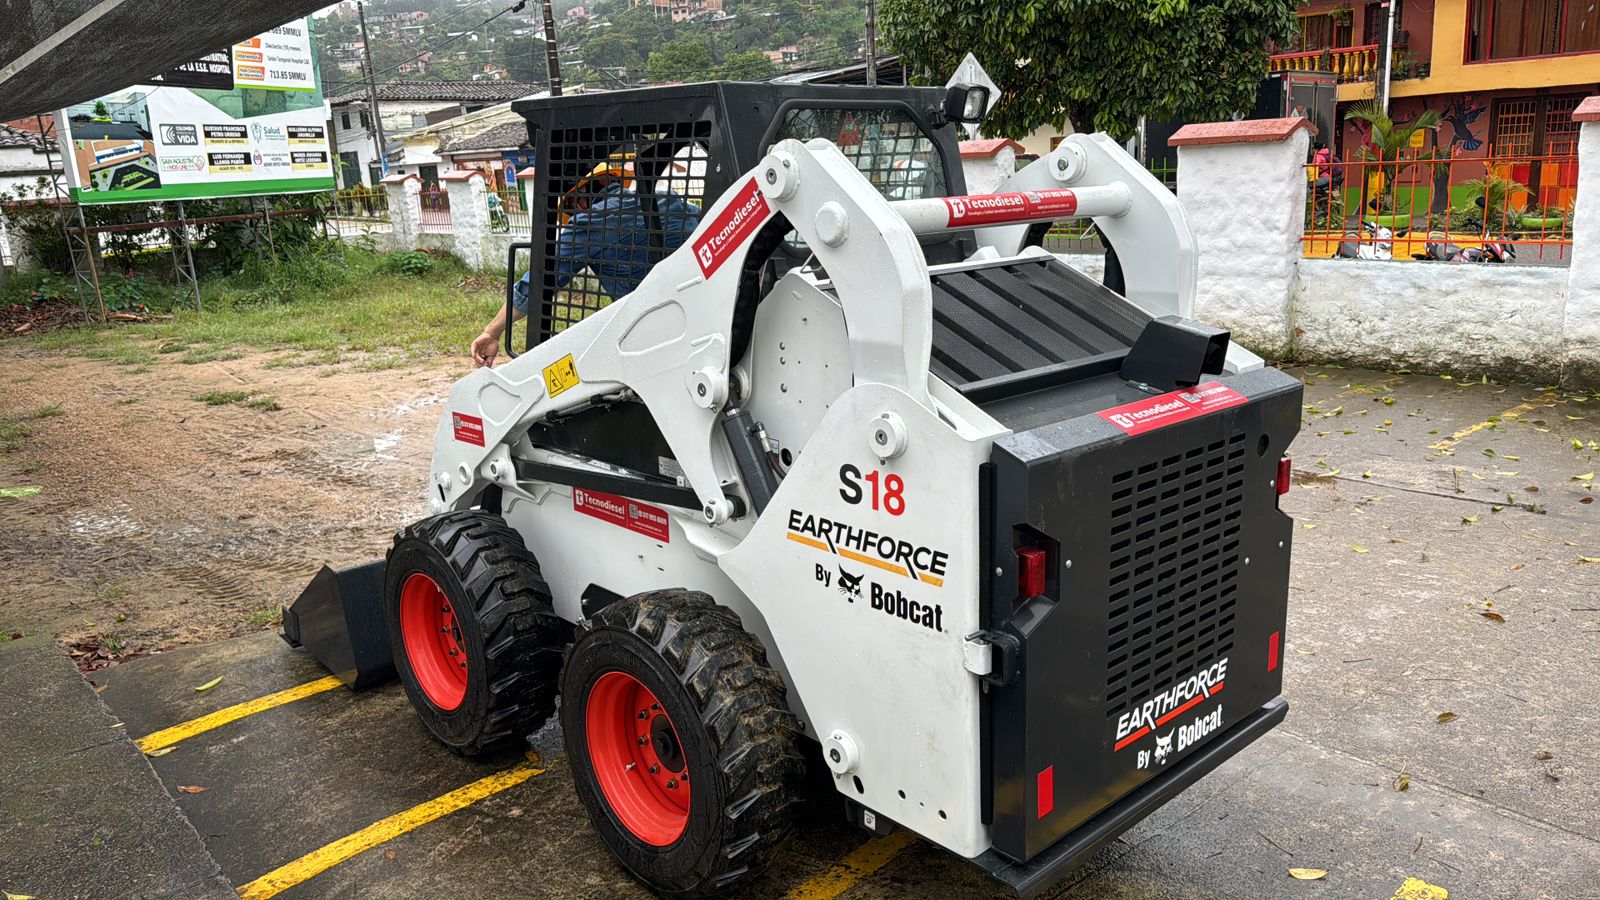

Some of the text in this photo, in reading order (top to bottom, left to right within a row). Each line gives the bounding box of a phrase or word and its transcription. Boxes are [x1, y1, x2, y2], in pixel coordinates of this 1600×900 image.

[187, 62, 194, 72] LA
[208, 64, 231, 74] HOSPITAL
[270, 70, 306, 80] 713.85 SMMLV
[176, 135, 196, 144] VIDA
[264, 126, 280, 134] Salud
[964, 195, 1024, 210] Tecnodiesel
[708, 190, 760, 250] Tecnodiesel
[1126, 399, 1186, 421] Tecnodiesel
[839, 464, 906, 516] S18
[584, 493, 625, 515] Tecnodiesel
[788, 509, 948, 580] EARTHFORCE
[815, 563, 943, 632] By Bobcat
[1116, 658, 1228, 740] EARTHFORCE
[1137, 704, 1224, 770] By Bobcat
